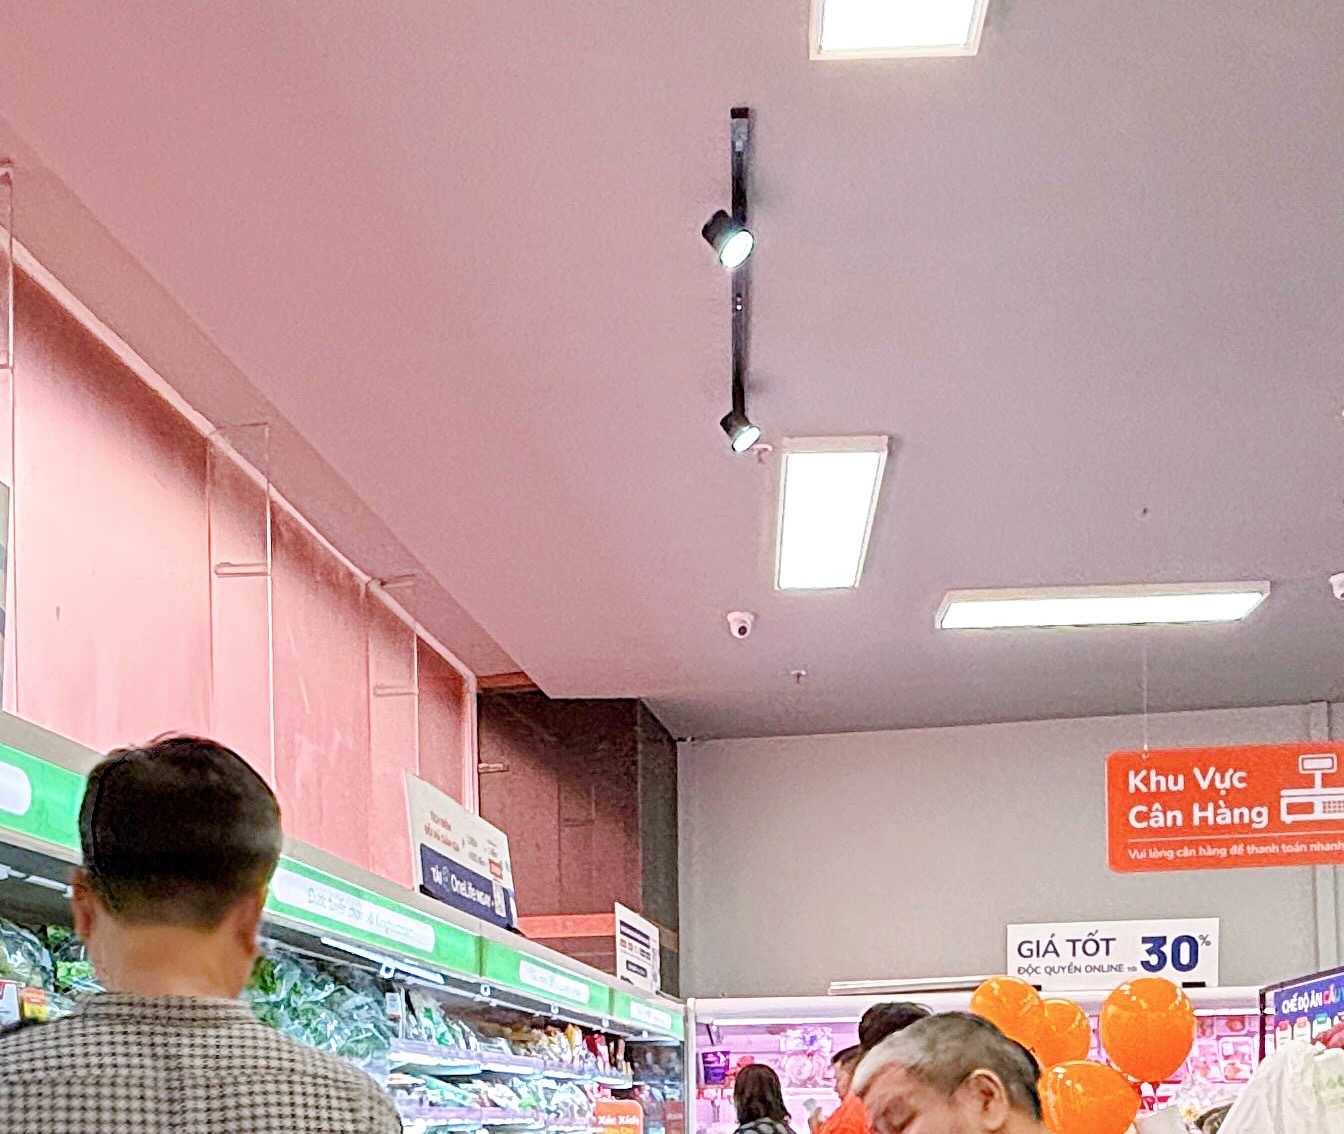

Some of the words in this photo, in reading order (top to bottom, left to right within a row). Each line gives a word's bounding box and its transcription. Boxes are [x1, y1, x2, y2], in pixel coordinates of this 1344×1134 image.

[1128, 769, 1184, 793] Khu
[1193, 766, 1247, 795] Vực
[1128, 802, 1183, 829] Cân
[1192, 801, 1269, 829] Hàng
[1128, 849, 1147, 860] Vui
[1148, 847, 1174, 861] lòng
[1176, 847, 1197, 858] cân
[1199, 845, 1227, 859] hàng
[1246, 843, 1280, 855] thanh
[1282, 842, 1307, 853] toán
[1309, 841, 1344, 852] nhanh
[1017, 933, 1060, 959] GIÁ
[1065, 929, 1116, 958] TỐT
[1017, 963, 1041, 977] ĐỘC
[1085, 963, 1124, 974] ONLINE
